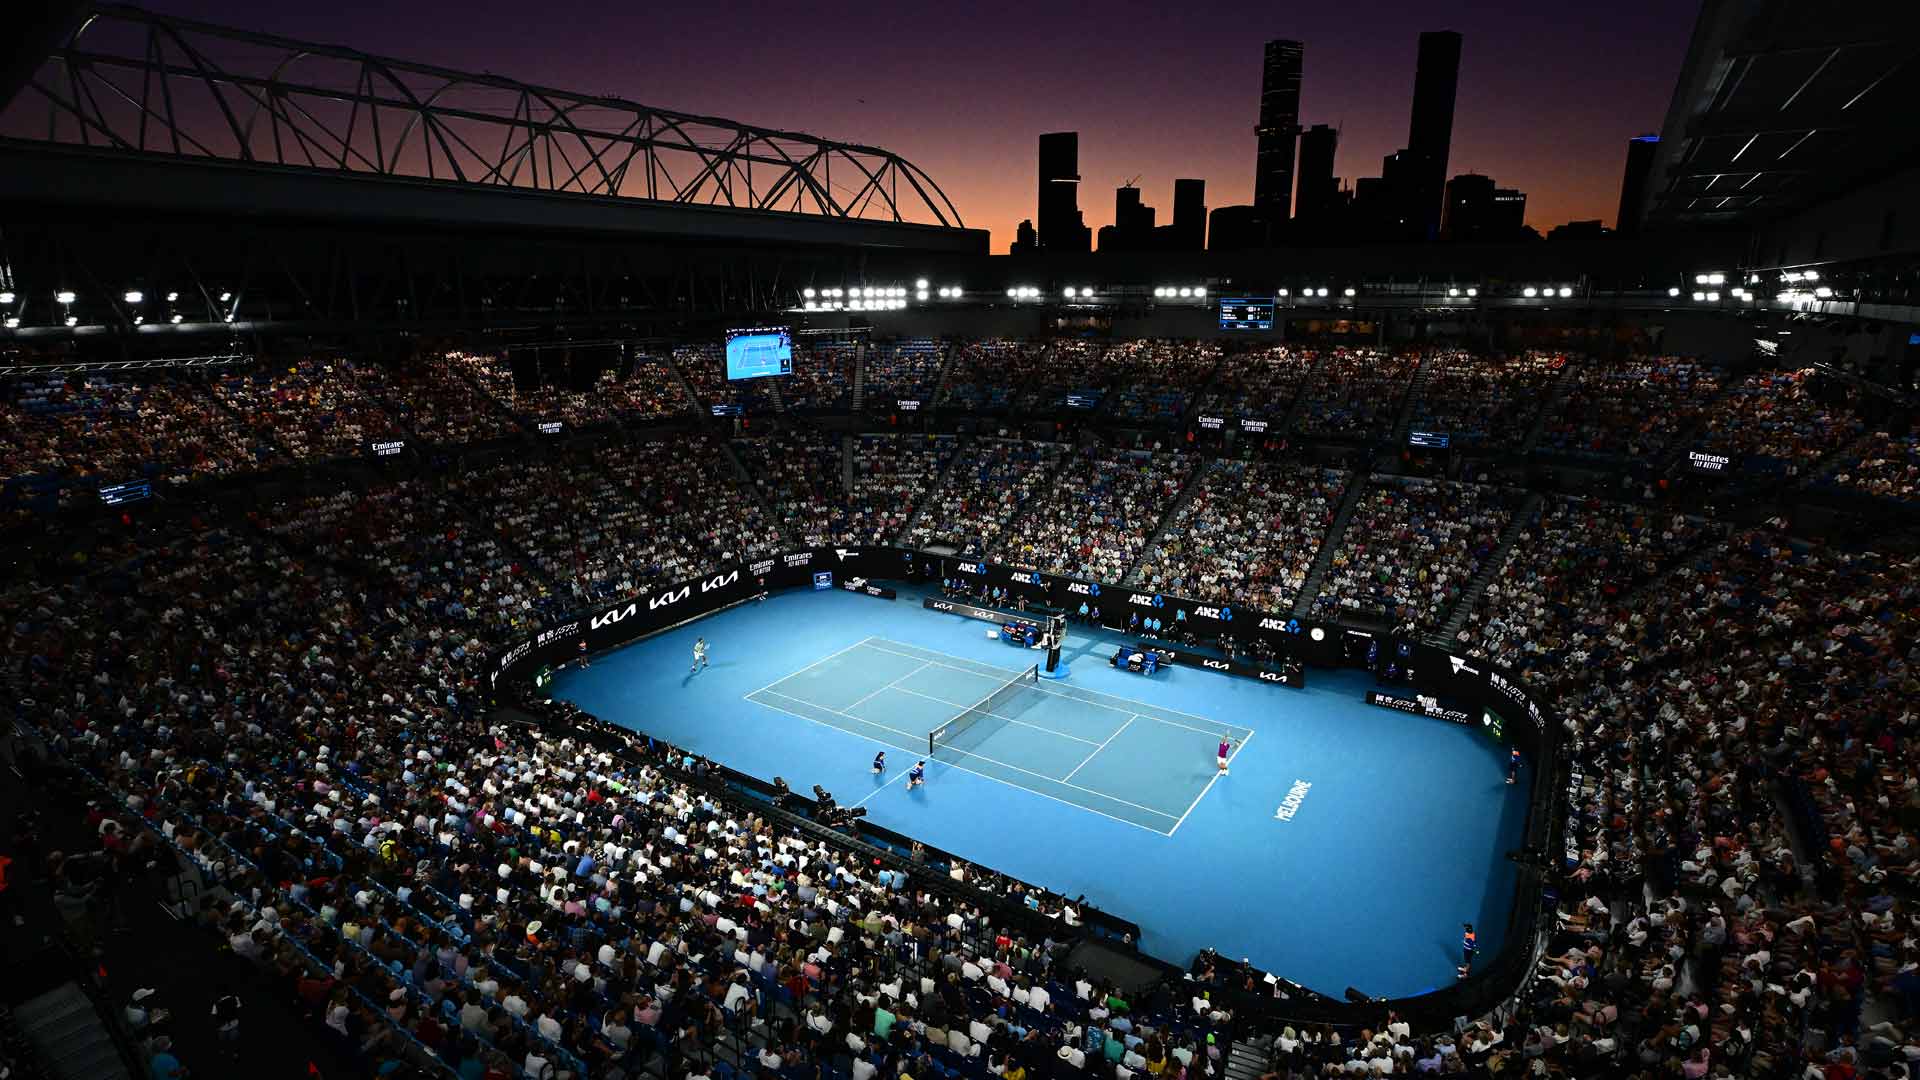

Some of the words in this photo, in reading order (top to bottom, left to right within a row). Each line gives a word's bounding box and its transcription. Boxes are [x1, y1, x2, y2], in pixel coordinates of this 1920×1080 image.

[371, 441, 405, 451] Emirates
[1689, 451, 1729, 464] Emirates
[783, 552, 813, 563] Emirates
[749, 560, 775, 571] Emirates
[957, 562, 977, 574] ANZ
[702, 570, 738, 593] KIA
[1010, 572, 1032, 584] ANZ
[1067, 582, 1089, 595] ANZ
[649, 586, 690, 610] KIA
[1128, 593, 1153, 606] ANZ
[591, 603, 636, 630] KIA
[1194, 606, 1220, 619] ANZ
[555, 621, 579, 636] 1573
[1259, 618, 1286, 632] ANZ
[513, 641, 531, 659] 1573
[1203, 659, 1230, 670] KIA
[1260, 671, 1287, 682] KIA
[1507, 685, 1526, 701] 1573
[1393, 699, 1416, 708] 1573
[1444, 710, 1468, 719] 1573
[1273, 778, 1313, 822] MELBOURNE
